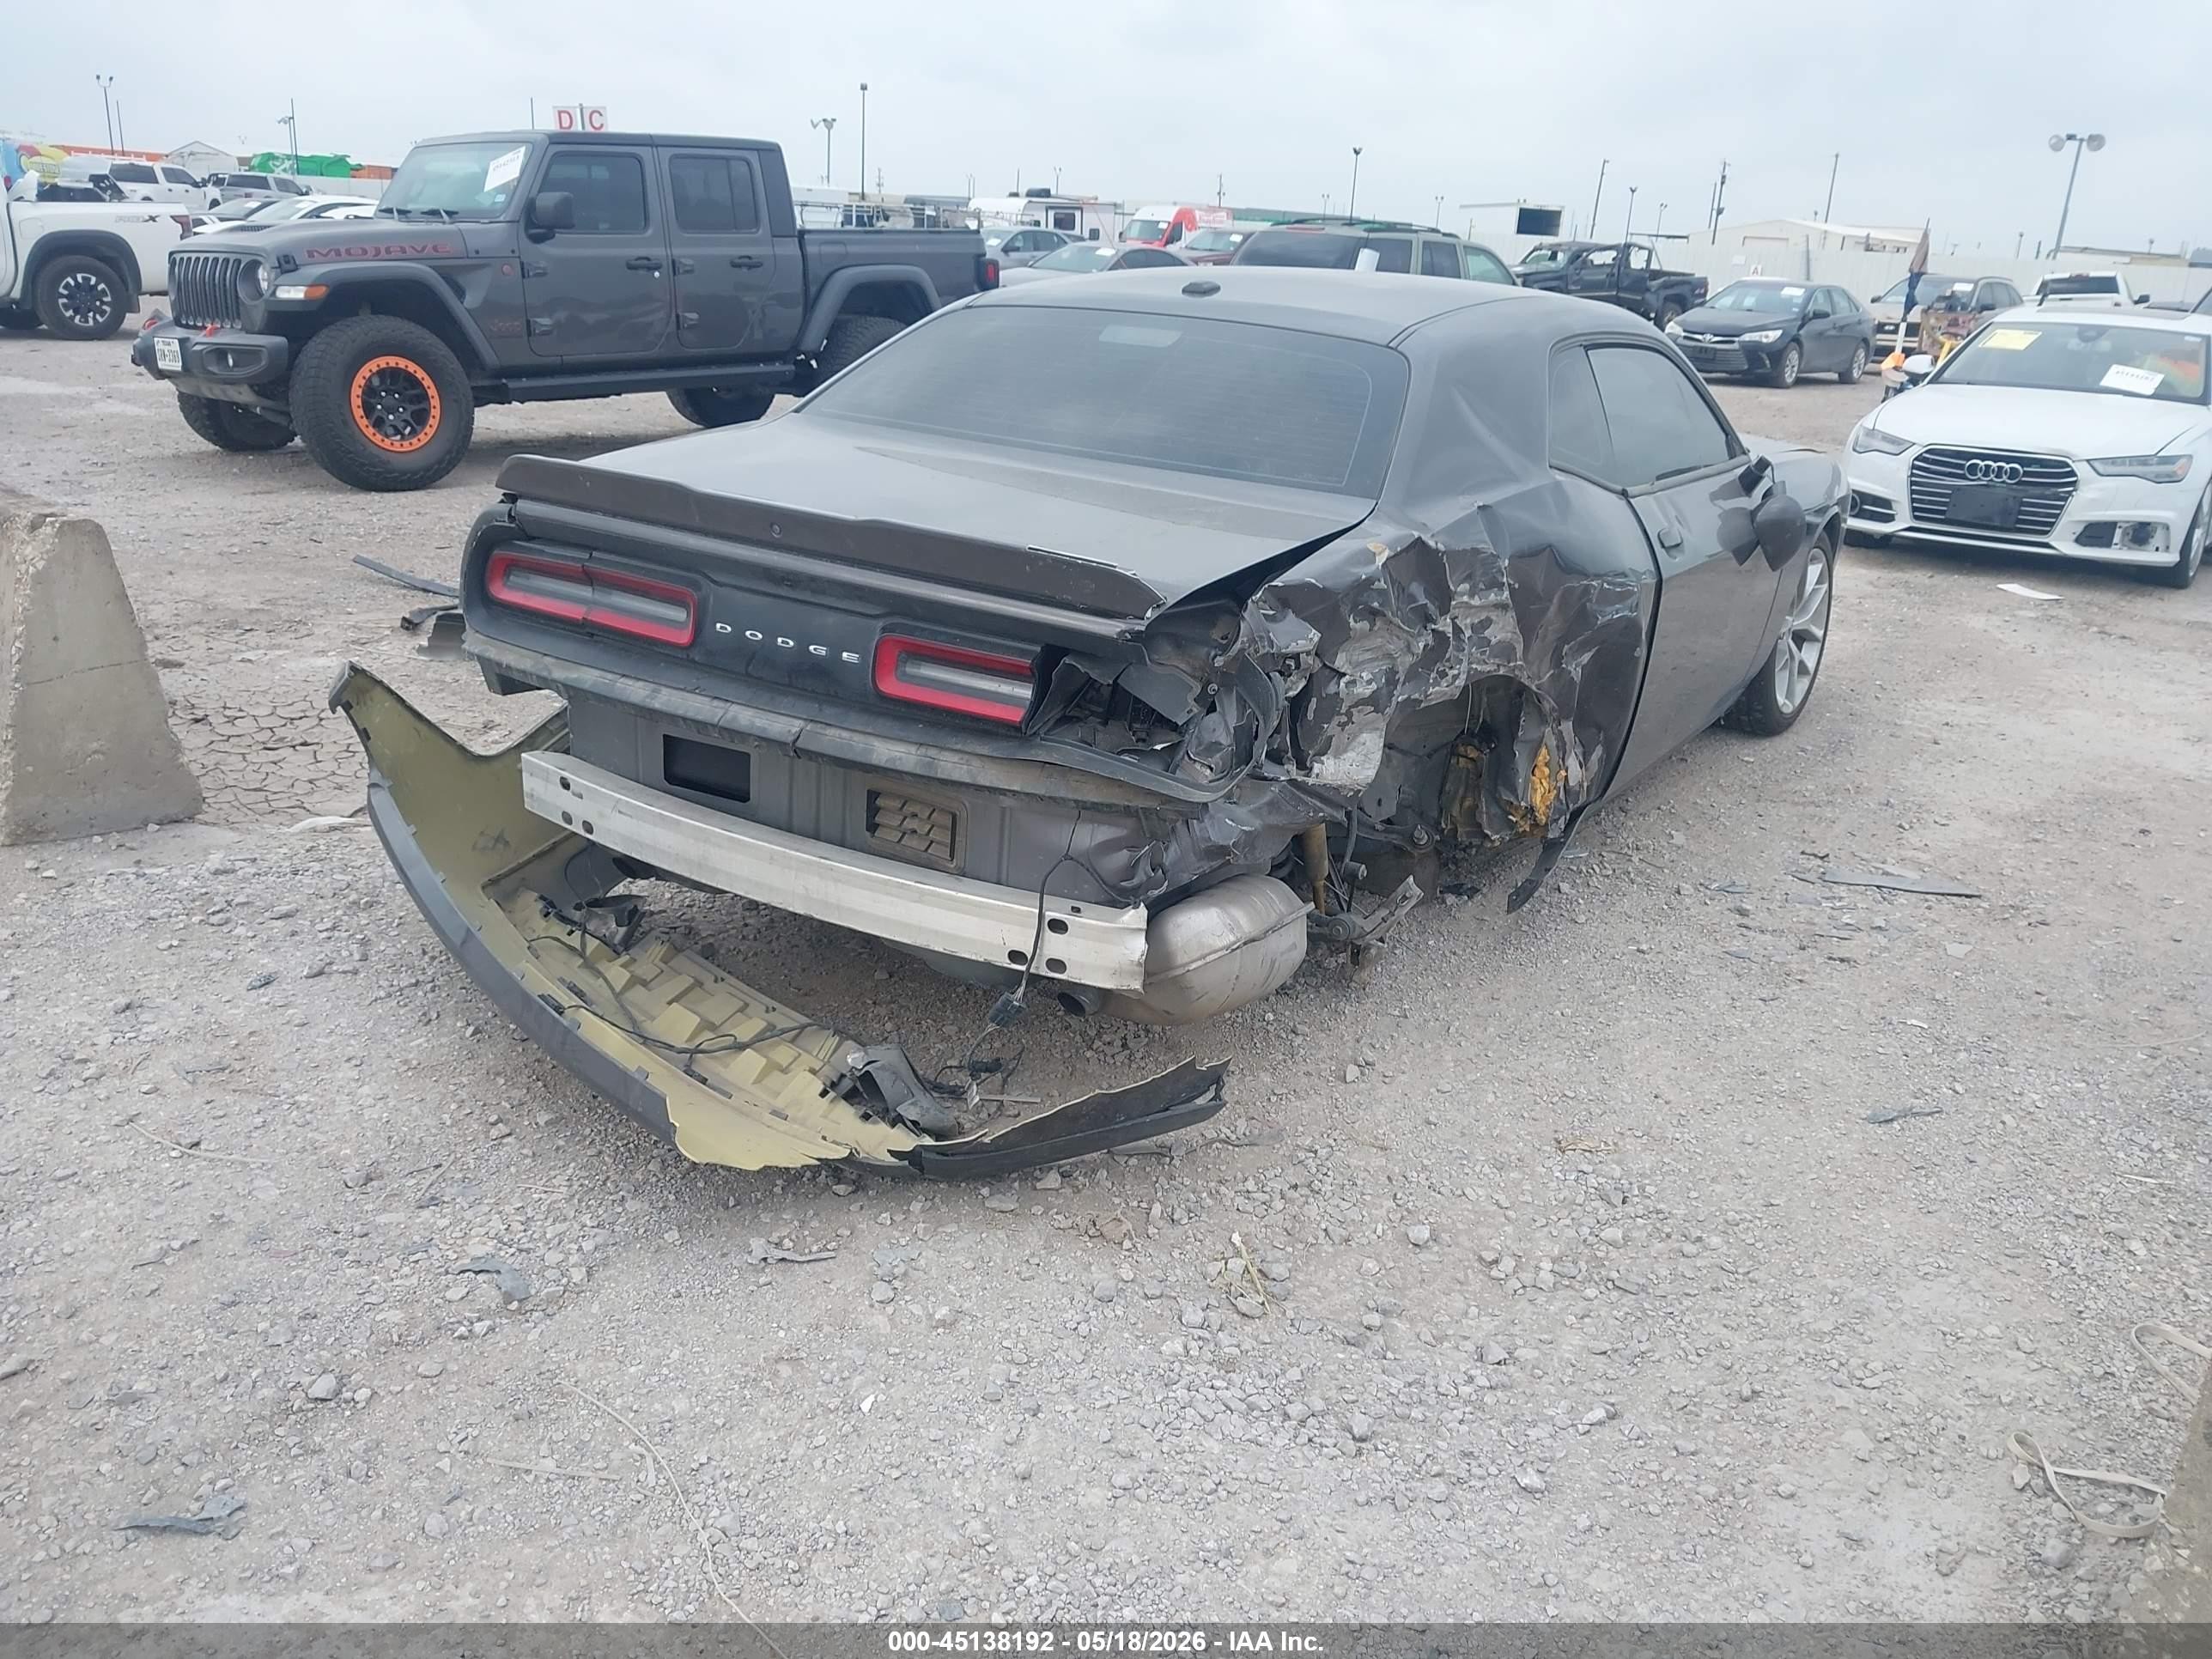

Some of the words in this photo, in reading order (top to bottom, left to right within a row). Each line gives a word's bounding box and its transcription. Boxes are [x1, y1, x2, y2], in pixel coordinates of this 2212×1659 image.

[557, 109, 574, 130] D
[589, 109, 605, 131] C
[305, 244, 451, 258] MOJAVE
[715, 622, 860, 664] DODGE
